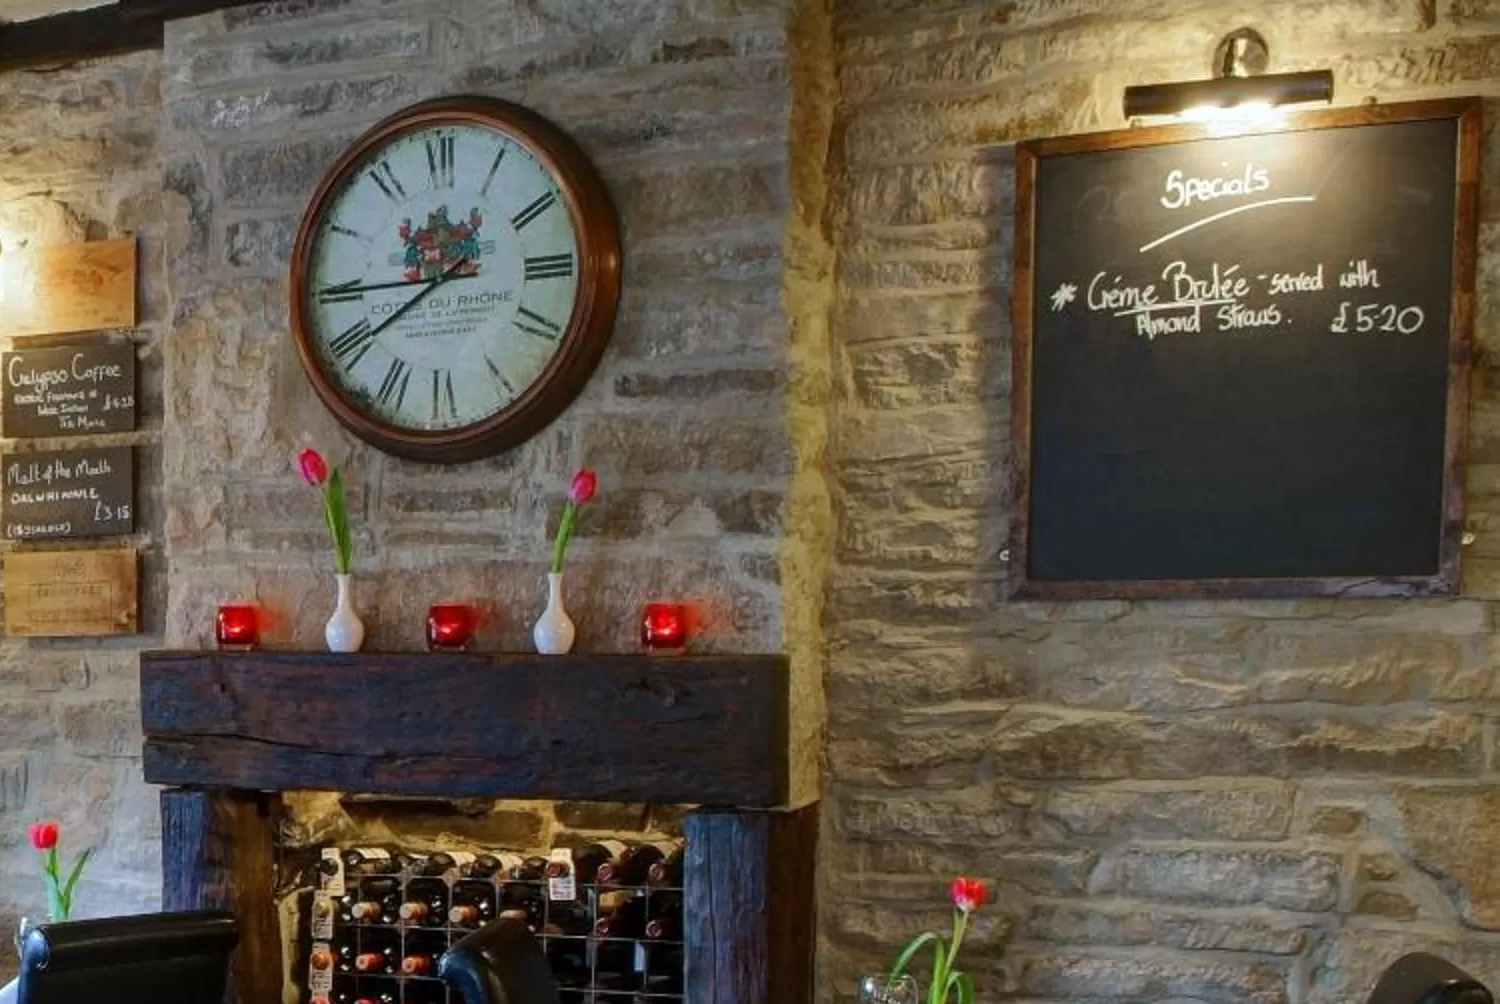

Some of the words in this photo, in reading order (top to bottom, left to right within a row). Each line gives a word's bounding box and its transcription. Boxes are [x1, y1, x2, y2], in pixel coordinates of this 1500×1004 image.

[1160, 162, 1270, 209] Specials
[1340, 259, 1380, 289] with
[1136, 303, 1202, 341] Almond
[8, 356, 70, 394] Calypso
[71, 353, 122, 383] Coffee
[8, 462, 41, 486] Malt
